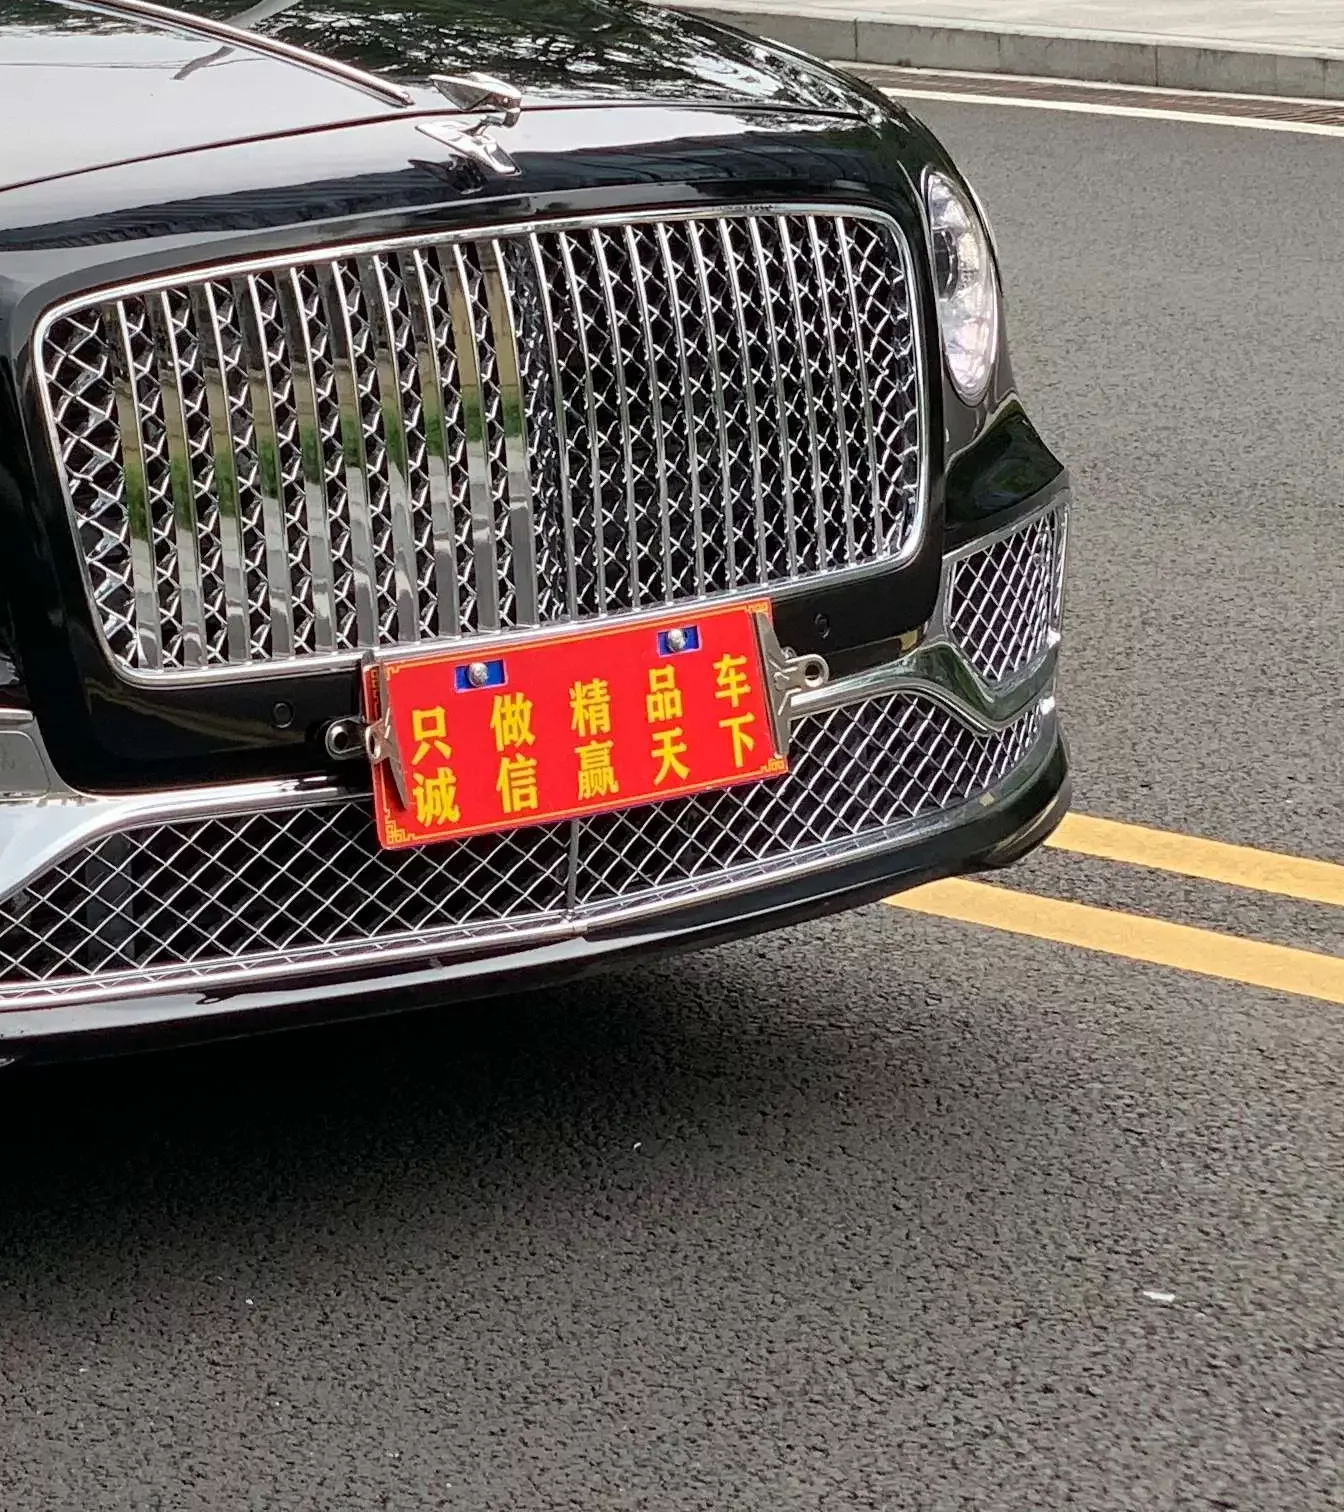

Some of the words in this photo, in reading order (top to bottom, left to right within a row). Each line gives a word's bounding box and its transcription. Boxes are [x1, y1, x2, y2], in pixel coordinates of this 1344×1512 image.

[411, 653, 752, 765] 只做精品车
[412, 713, 755, 826] 诚信赢天下
